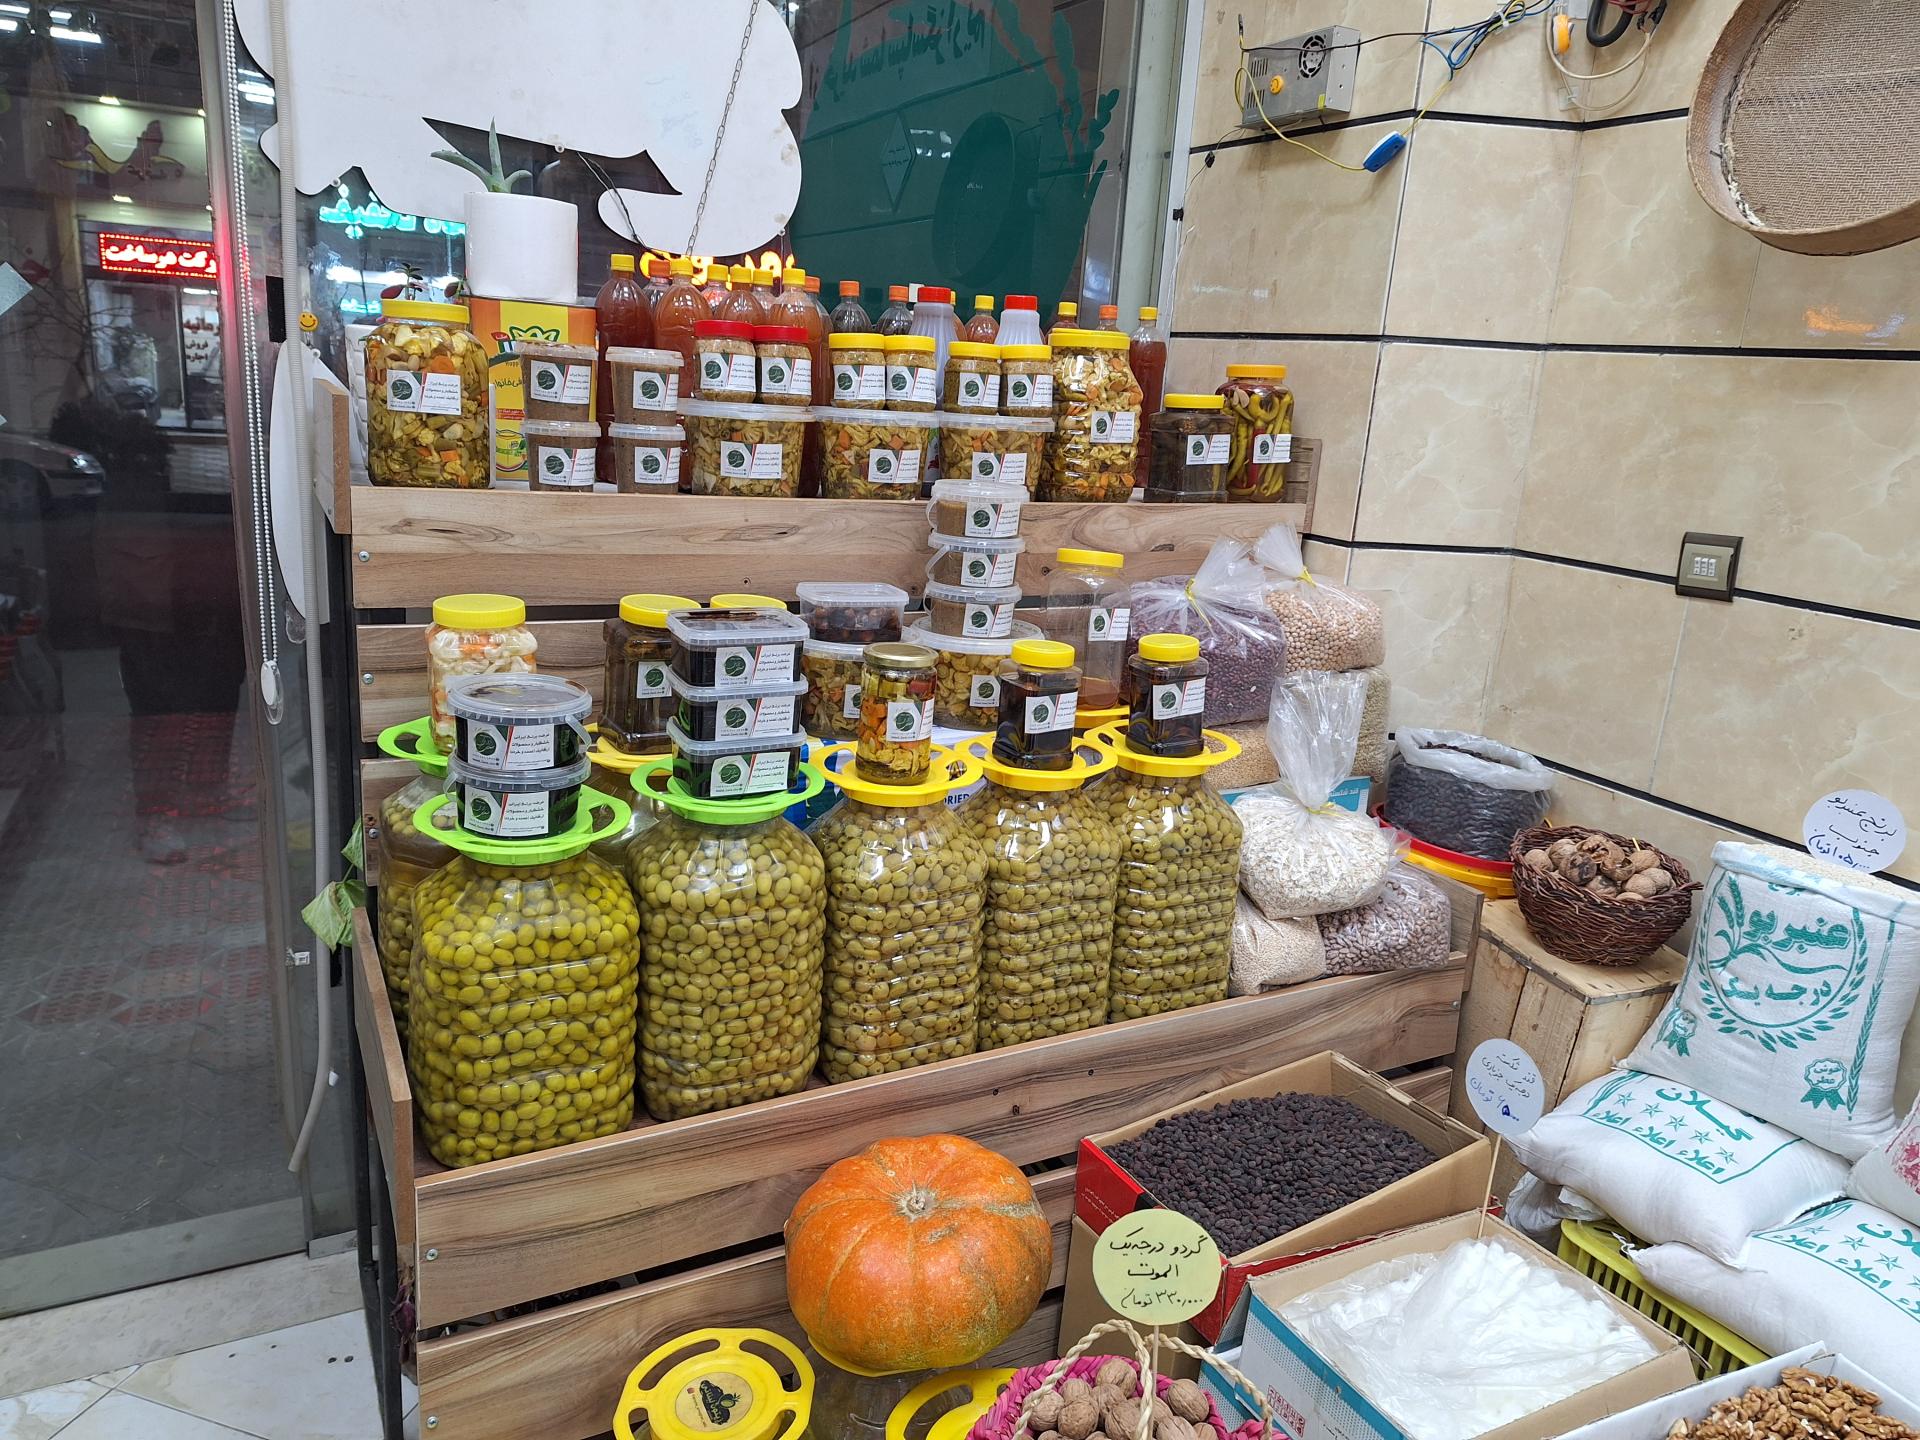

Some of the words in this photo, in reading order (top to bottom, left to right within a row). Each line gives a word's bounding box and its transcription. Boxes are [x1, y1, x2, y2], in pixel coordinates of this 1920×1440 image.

[1859, 811, 1898, 842] برنج
[1829, 823, 1880, 857] جنوب
[1771, 916, 1852, 954] عنبر
[1721, 976, 1759, 1006] یک
[1765, 979, 1832, 1007] درجه
[1470, 1077, 1494, 1102] تومان
[1522, 1071, 1537, 1084] قند
[1170, 1234, 1208, 1259] گردو
[1127, 1262, 1179, 1280] الموت
[1121, 1288, 1153, 1308] تومان
